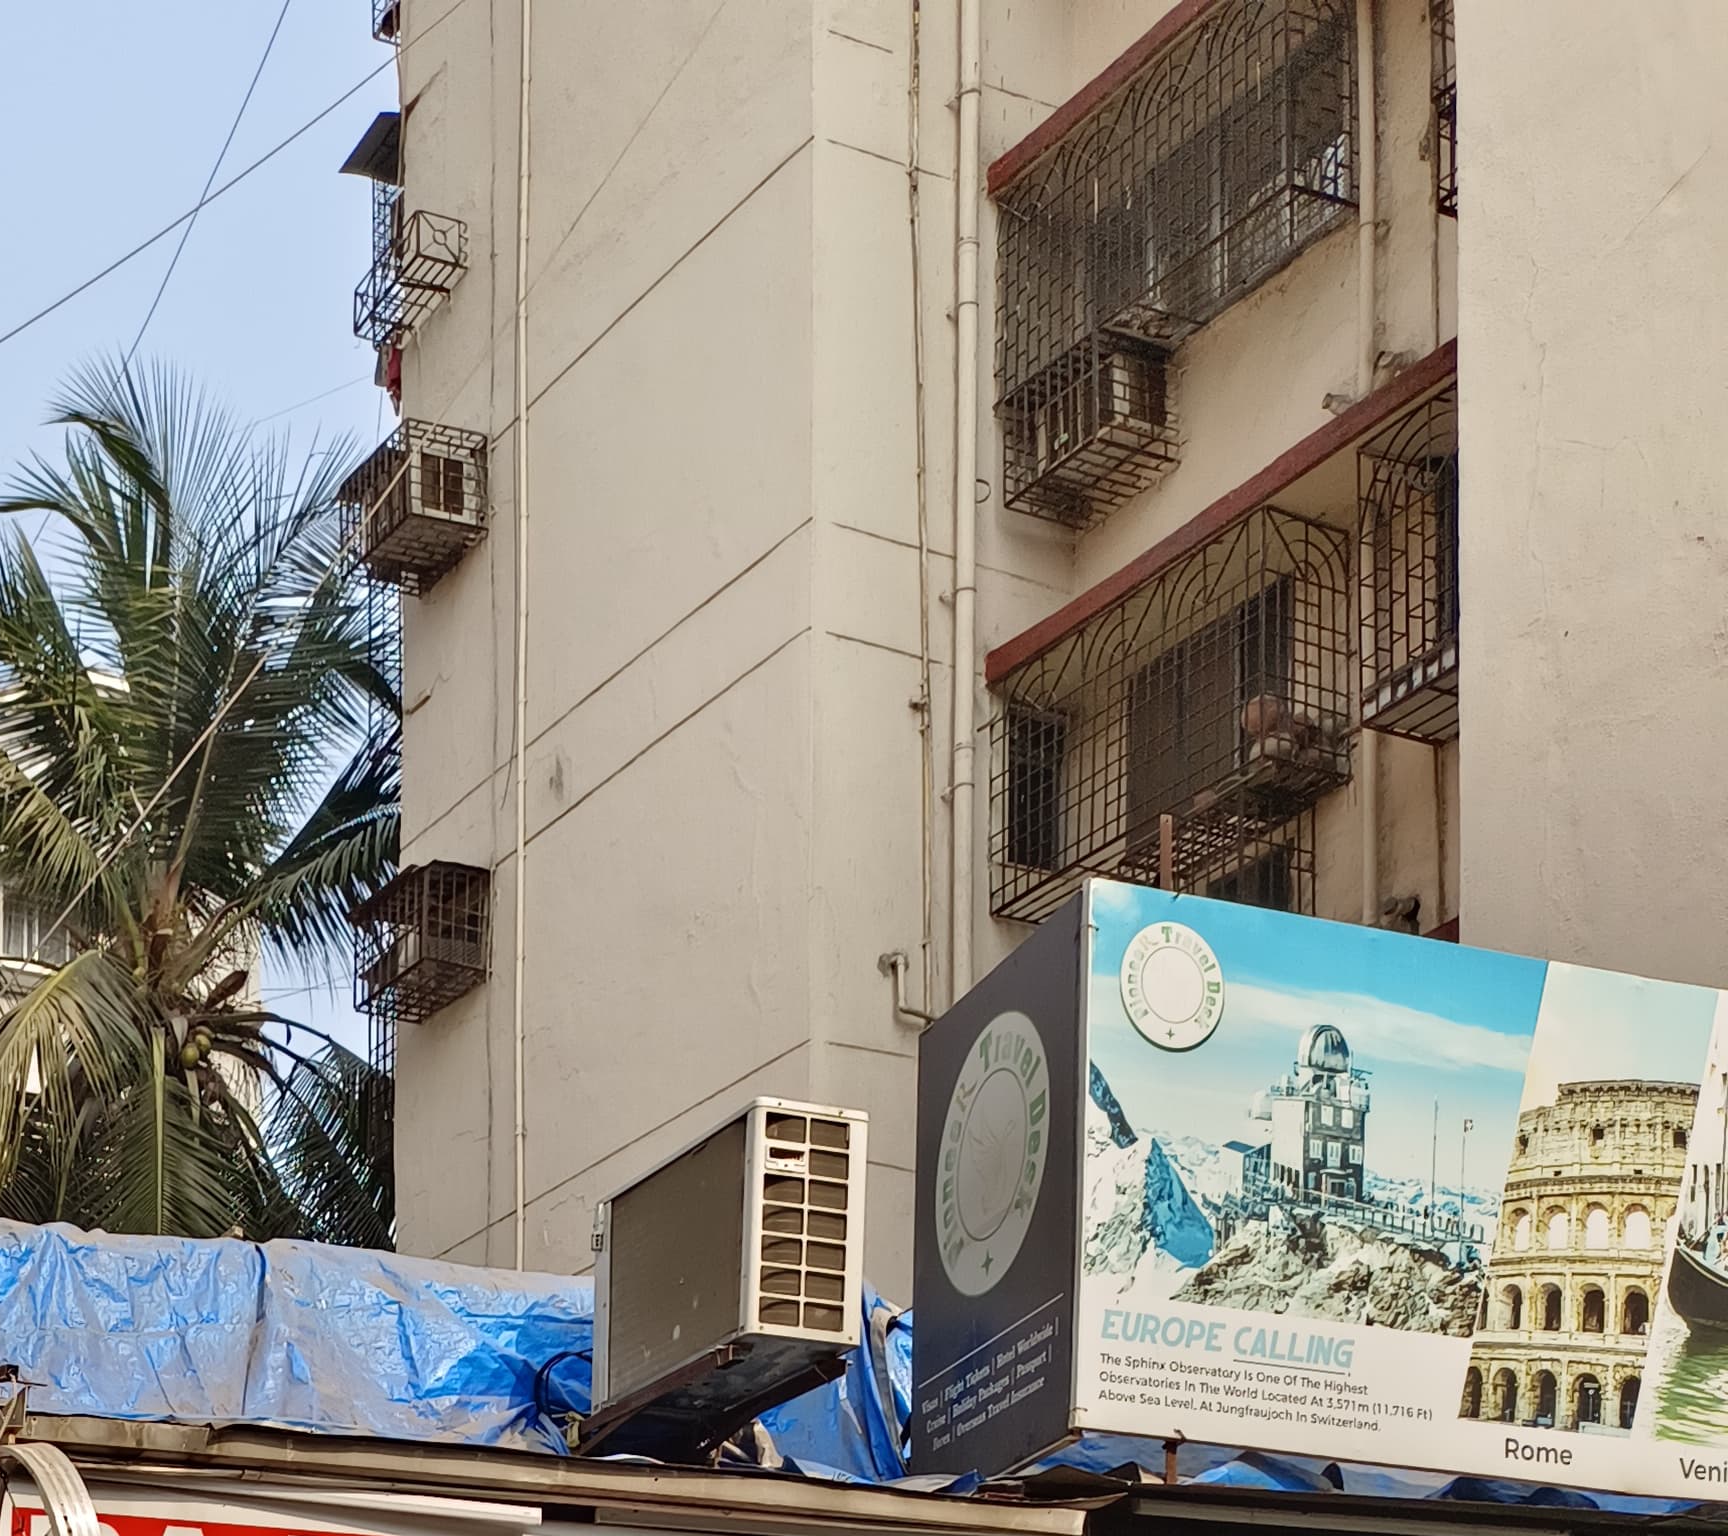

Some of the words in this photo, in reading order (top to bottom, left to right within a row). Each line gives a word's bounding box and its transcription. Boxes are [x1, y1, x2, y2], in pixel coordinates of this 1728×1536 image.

[1100, 1309, 1227, 1353] EUROPE
[1233, 1326, 1355, 1370] CALLING
[1099, 1370, 1181, 1392] Observatories
[1184, 1381, 1196, 1392] In
[1199, 1381, 1221, 1395] The
[1223, 1384, 1259, 1400] World
[1261, 1389, 1307, 1407] Located
[1100, 1352, 1121, 1367] The
[1124, 1355, 1166, 1374] Sphinx
[1169, 1361, 1241, 1382] Observatory
[1256, 1371, 1281, 1385] One
[1301, 1376, 1321, 1390] The
[1324, 1379, 1369, 1396] Highest
[1098, 1389, 1136, 1403] Above
[1139, 1393, 1161, 1406] Sea
[1216, 1401, 1293, 1421] Jungfraujoch
[1504, 1438, 1572, 1465] Rome
